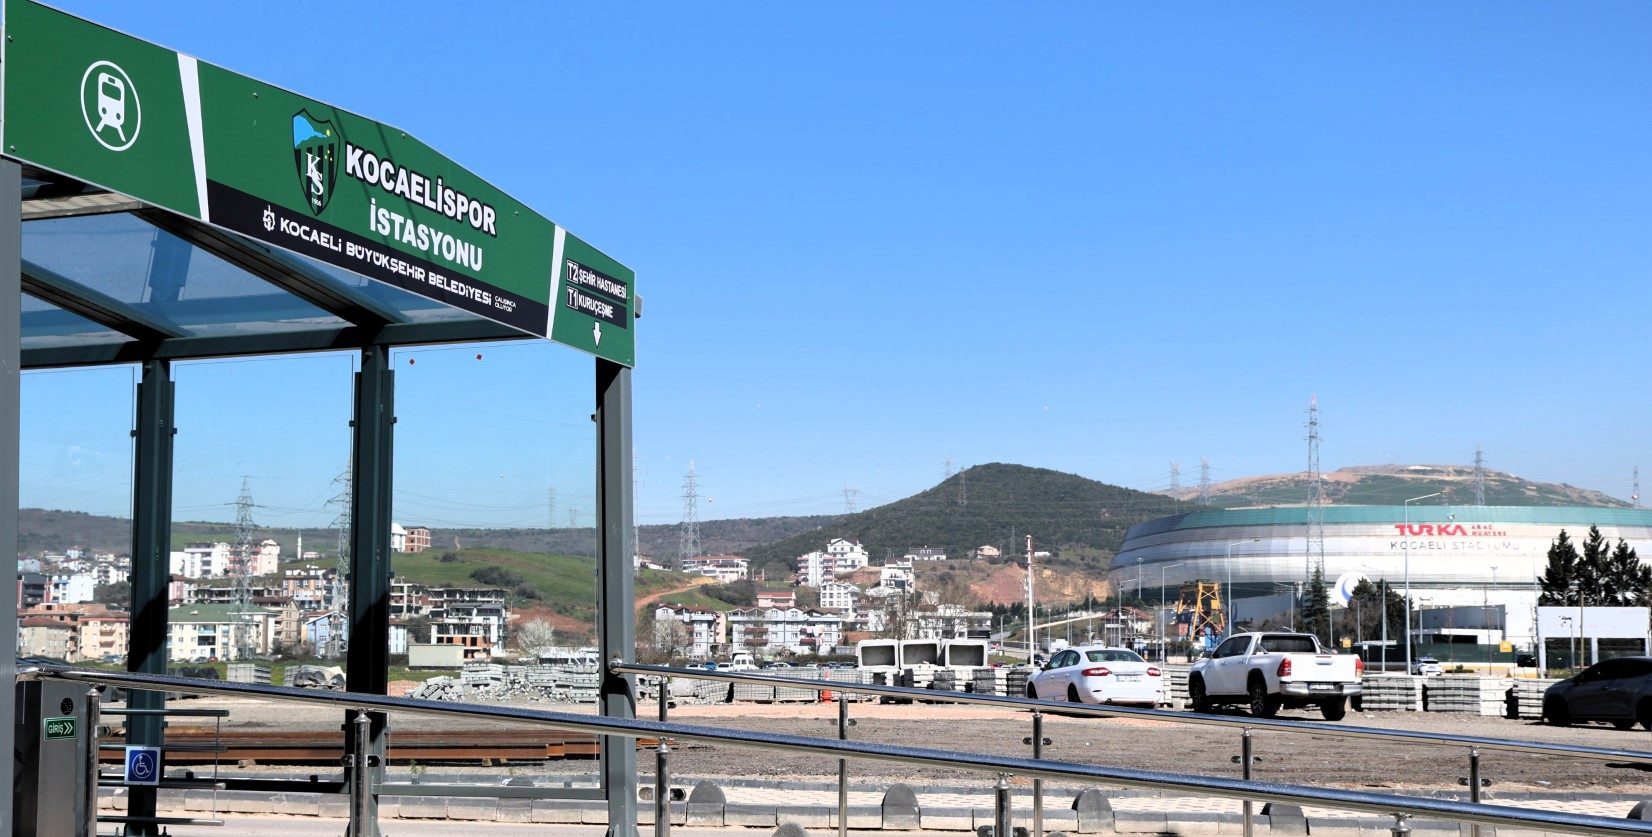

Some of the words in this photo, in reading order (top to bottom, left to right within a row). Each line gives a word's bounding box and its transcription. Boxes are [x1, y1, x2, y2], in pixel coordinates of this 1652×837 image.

[345, 143, 497, 236] KOCAELİSPOR
[369, 198, 483, 272] İSTASYONU
[346, 241, 426, 282] BÜYÜKŞEHİR
[428, 271, 492, 306] BELEDİYESİ
[567, 262, 578, 282] T2
[578, 269, 596, 286] ŞEHİR
[597, 277, 627, 299] HASTANESİ
[567, 288, 578, 307] T1
[578, 293, 613, 318] KURUÇEŞME
[1395, 524, 1467, 536] TURKA
[48, 723, 64, 734] GİRİŞ
